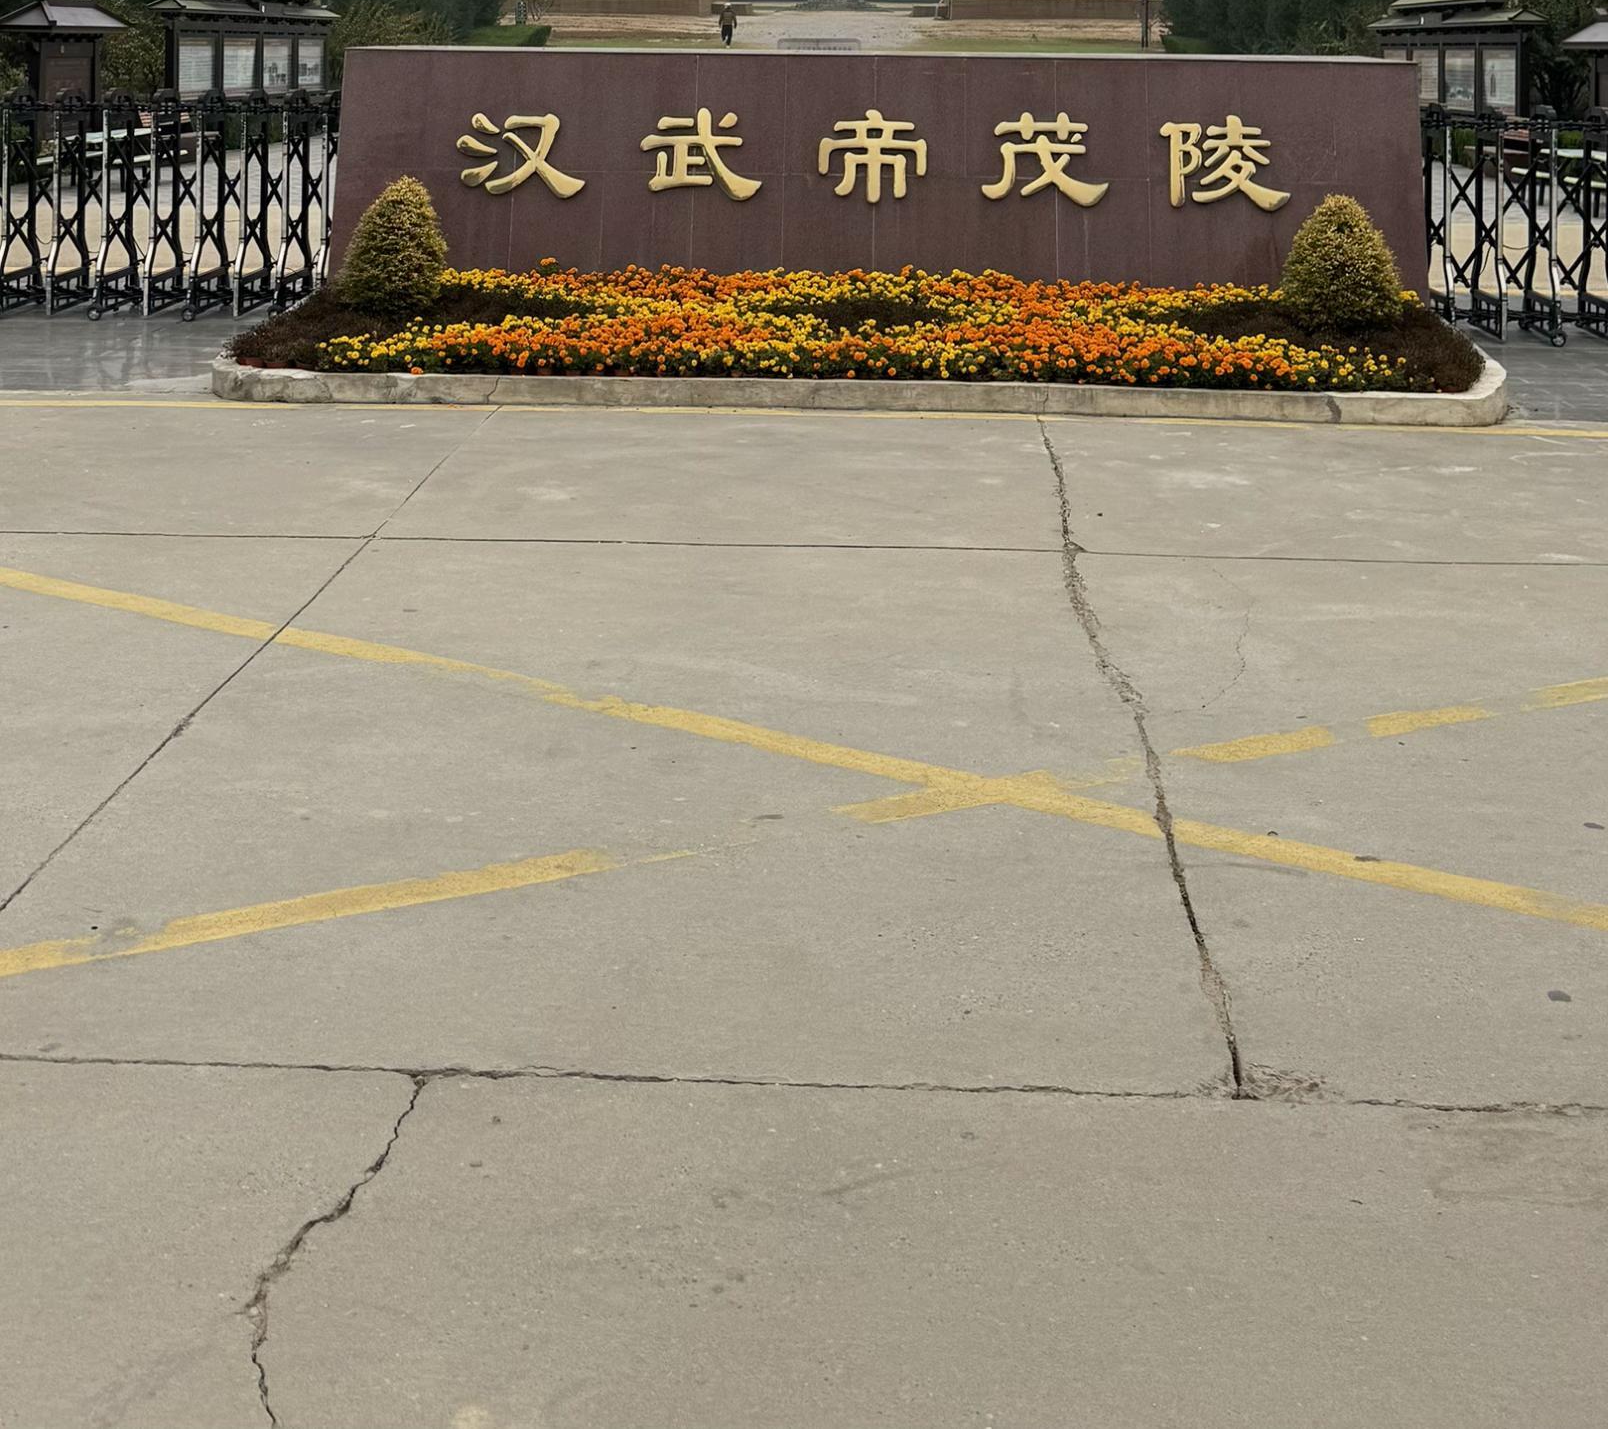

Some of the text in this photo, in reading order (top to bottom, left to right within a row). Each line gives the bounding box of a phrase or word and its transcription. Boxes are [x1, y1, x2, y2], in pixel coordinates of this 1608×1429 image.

[455, 107, 1291, 210] 汉武帝茂陵
